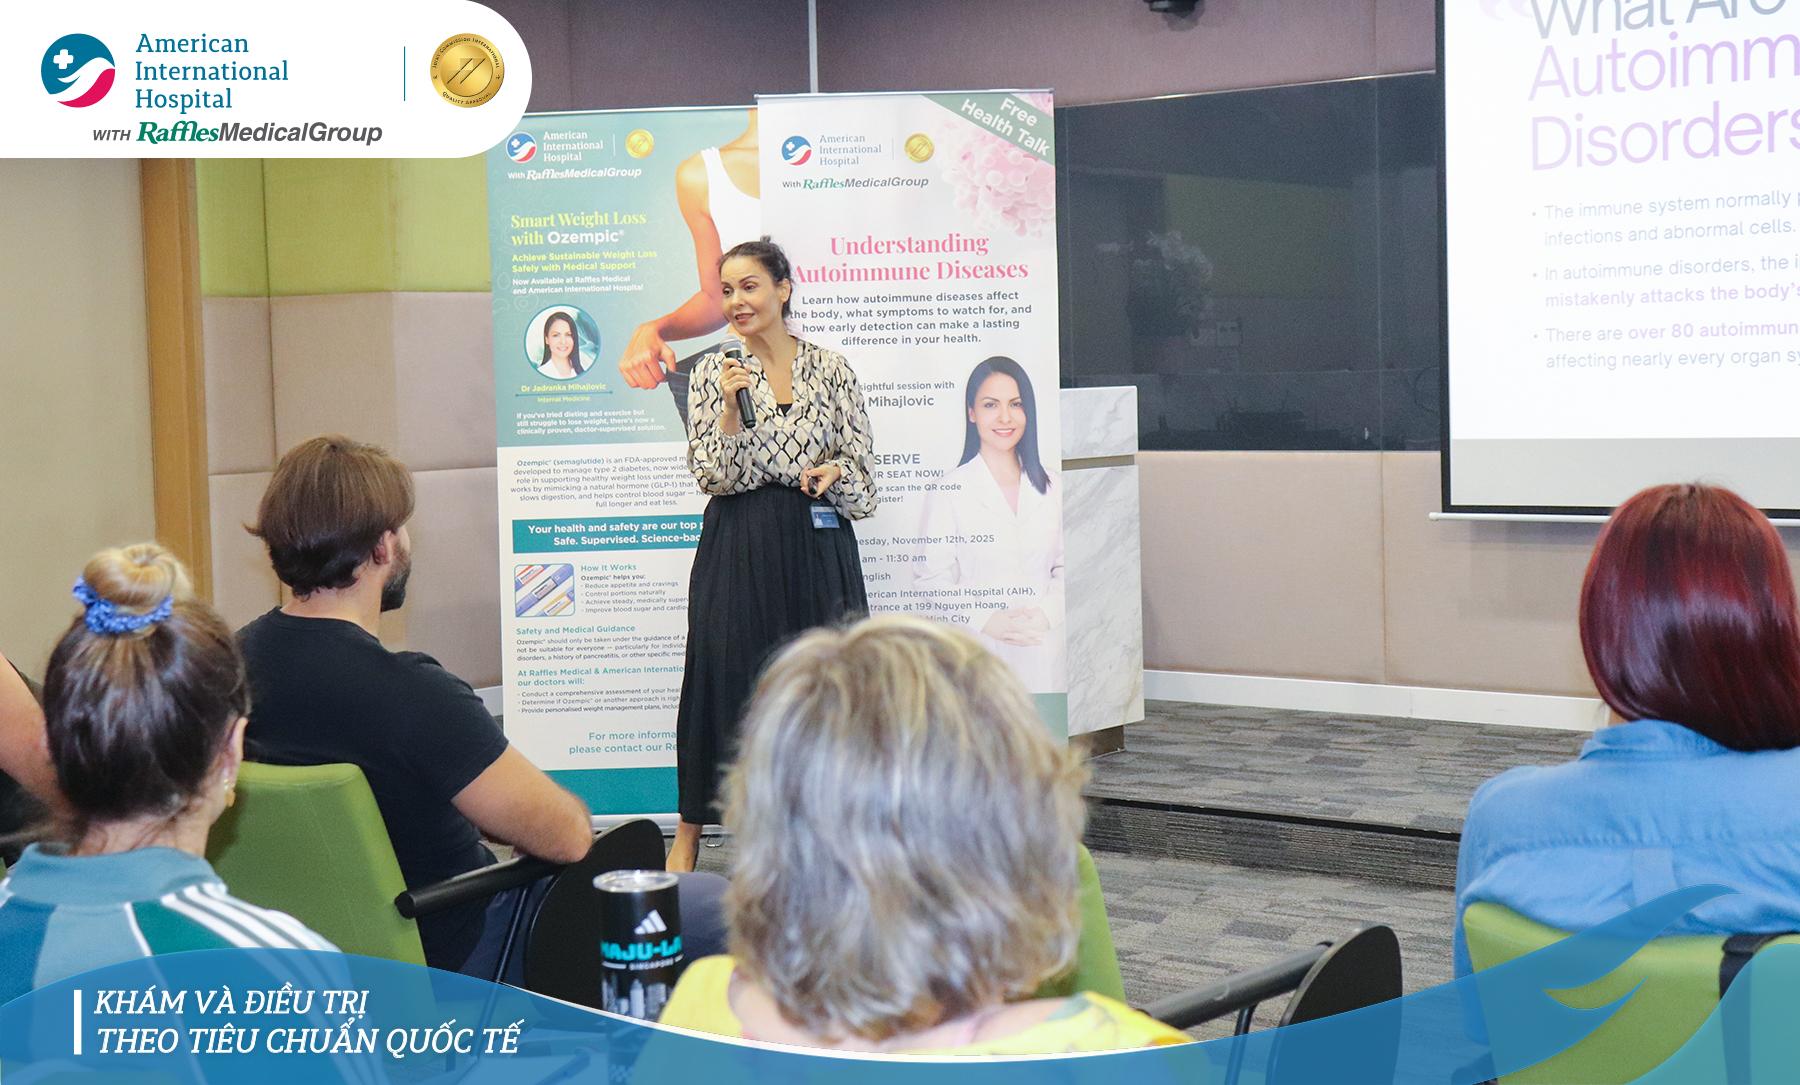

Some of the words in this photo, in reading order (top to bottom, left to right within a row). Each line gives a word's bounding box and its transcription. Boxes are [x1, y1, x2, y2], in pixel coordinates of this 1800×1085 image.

[1533, 0, 1673, 39] What
[1528, 31, 1800, 101] Autoimm
[1000, 98, 1038, 127] Free
[961, 99, 1012, 136] Health
[1018, 128, 1050, 157] Talk
[543, 132, 587, 140] American
[820, 134, 865, 143] American
[543, 141, 603, 151] International
[819, 144, 882, 154] International
[544, 152, 582, 164] Hospital
[820, 156, 859, 168] Hospital
[782, 180, 801, 188] With
[1544, 202, 1574, 219] The
[1578, 202, 1642, 216] immune
[1648, 198, 1710, 216] system
[1716, 191, 1791, 212] normally
[511, 215, 556, 228] Smart
[558, 212, 609, 228] Weight
[613, 211, 647, 225] Loss
[511, 231, 544, 245] with
[1544, 228, 1622, 247] infections
[1628, 226, 1658, 242] and
[1664, 221, 1743, 240] abnormal
[1750, 219, 1795, 236] cells.
[830, 233, 989, 256] Understanding
[513, 254, 546, 262] Achieve
[550, 252, 599, 260] Sustainable
[603, 252, 635, 260] Weight
[513, 265, 539, 273] Safely
[600, 262, 636, 270] Support
[794, 262, 930, 284] Autoimmune
[937, 260, 1029, 280] Diseases
[1545, 268, 1558, 281] In
[1563, 262, 1663, 280] autoimmune
[1669, 258, 1755, 276] disorders,
[1761, 256, 1788, 271] the
[802, 295, 833, 305] Learn
[837, 294, 860, 304] how
[863, 293, 932, 303] autoimmune
[936, 292, 983, 302] diseases
[987, 291, 1019, 301] affect
[1546, 291, 1634, 309] mistakenly
[1640, 288, 1704, 304] attacks
[1711, 286, 1738, 301] the
[790, 309, 807, 319] the
[811, 308, 843, 320] body,
[846, 308, 873, 317] what
[877, 307, 934, 318] symptoms
[937, 307, 949, 316] to
[952, 305, 985, 315] watch
[989, 305, 1008, 315] for,
[1011, 304, 1032, 314] and
[802, 323, 825, 333] how
[829, 322, 856, 334] early
[860, 321, 913, 331] detection
[917, 321, 936, 330] can
[940, 320, 969, 329] make
[972, 320, 979, 329] a
[983, 319, 1020, 330] lasting
[1546, 328, 1592, 344] There
[1597, 328, 1622, 341] are
[1628, 325, 1665, 340] over
[1672, 323, 1694, 338] 80
[1700, 322, 1799, 338] autoimmun
[842, 334, 898, 345] difference
[902, 335, 911, 344] in
[915, 335, 940, 346] your
[943, 333, 982, 343] health.
[1546, 353, 1617, 371] affecting
[1622, 352, 1672, 369] nearly
[1678, 351, 1724, 367] every
[1730, 349, 1781, 366] organ
[860, 382, 894, 392] sightful
[897, 382, 931, 390] session
[935, 381, 954, 389] with
[869, 395, 934, 408] Mihajlovic
[875, 454, 920, 465] SERVE
[887, 470, 912, 478] SEAT
[528, 525, 552, 534] Your
[554, 523, 586, 532] health
[588, 523, 607, 532] and
[610, 522, 639, 533] safety
[680, 521, 697, 531] top
[554, 537, 578, 546] Safe.
[581, 535, 638, 546] Supervised.
[641, 534, 700, 543] Science-bac
[859, 538, 890, 546] esday,
[892, 536, 942, 545] November
[864, 573, 891, 582] nglish
[900, 589, 961, 598] International
[964, 588, 1004, 597] Hospital
[903, 603, 912, 611] at
[935, 602, 972, 611] Nguyen
[951, 615, 970, 623] City
[589, 732, 606, 740] For
[638, 731, 676, 739] informa
[569, 746, 600, 755] please
[605, 744, 642, 752] contact
